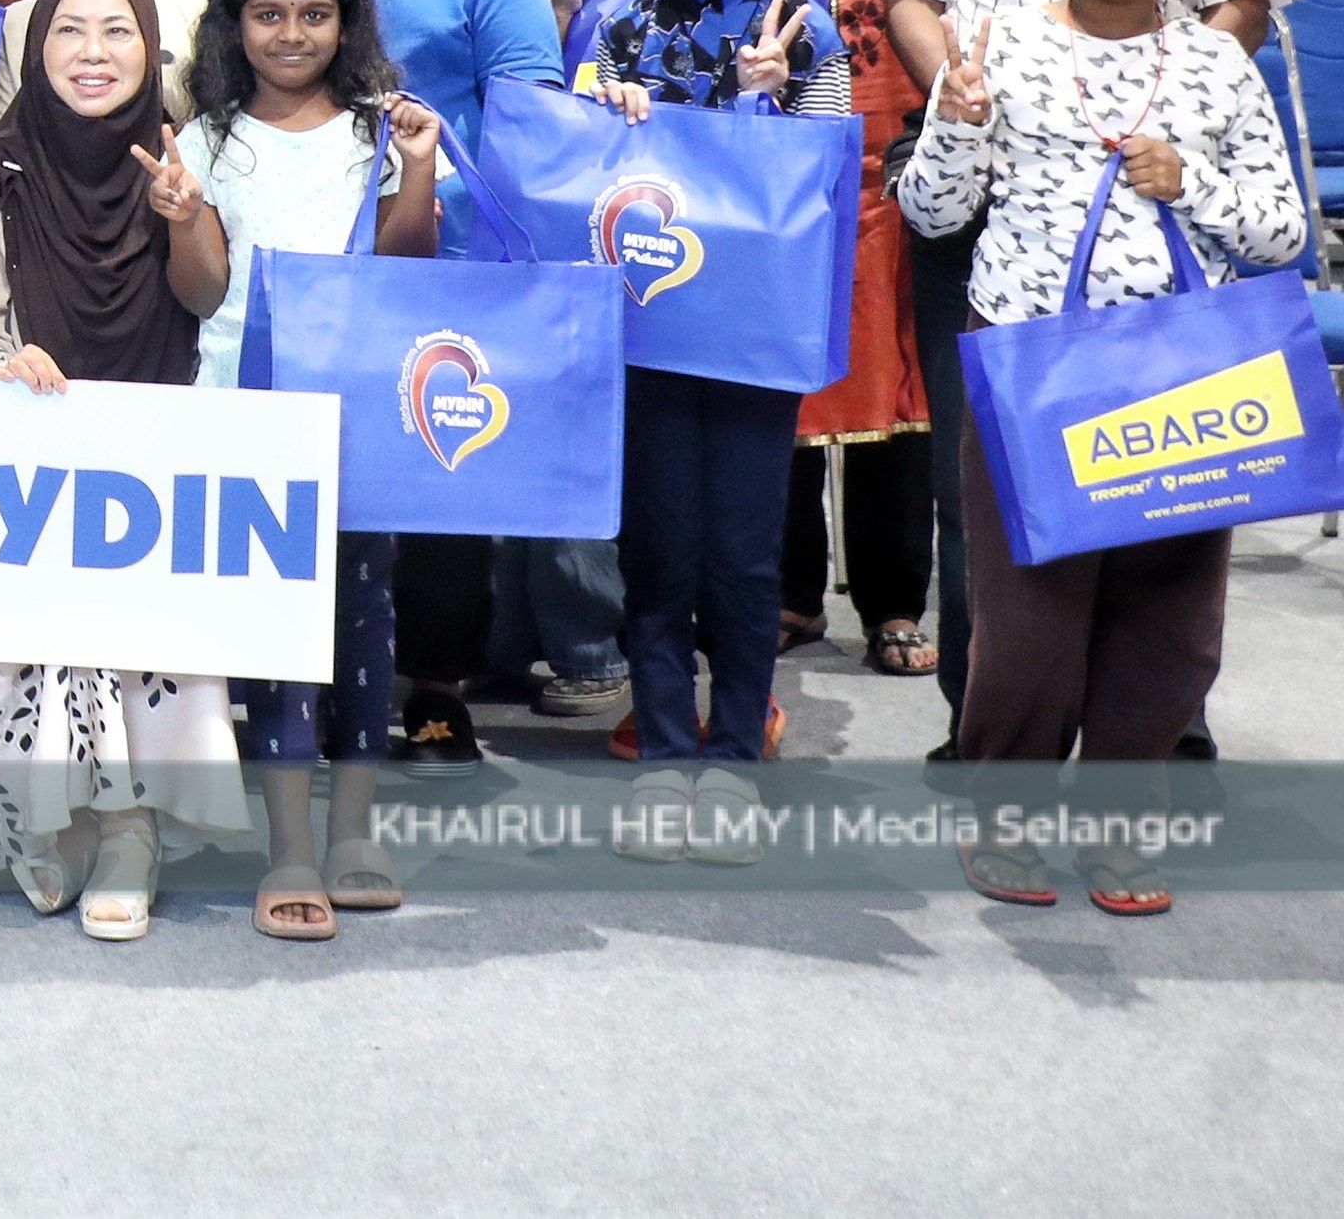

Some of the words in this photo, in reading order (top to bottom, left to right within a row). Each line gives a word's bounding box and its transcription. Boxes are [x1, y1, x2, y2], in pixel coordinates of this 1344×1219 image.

[622, 232, 678, 255] MYDIN
[432, 395, 485, 414] MYDIN
[1089, 398, 1269, 464] ABARO
[1178, 468, 1228, 487] PROTEK
[1237, 454, 1287, 473] ABARO
[1143, 492, 1251, 520] www.abaro.com.my
